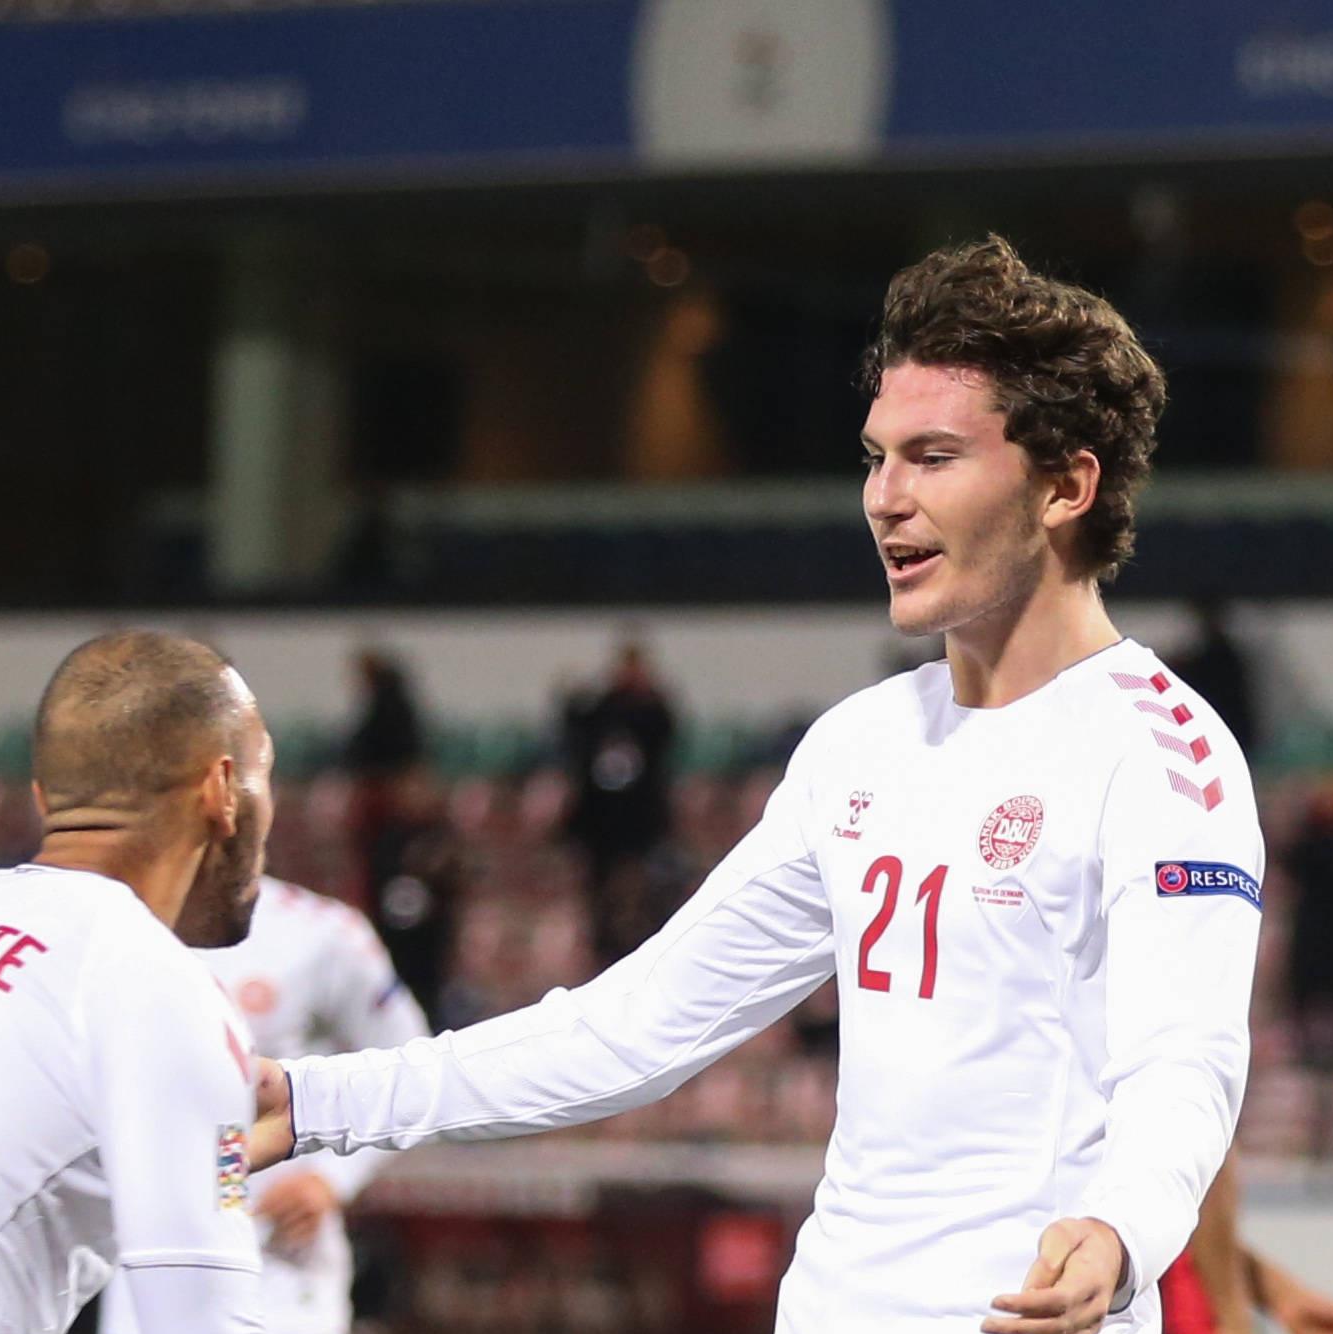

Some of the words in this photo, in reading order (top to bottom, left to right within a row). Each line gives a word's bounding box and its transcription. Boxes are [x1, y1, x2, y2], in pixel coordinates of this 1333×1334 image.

[992, 817, 1035, 844] DBU
[1191, 869, 1260, 902] RESPECT
[857, 855, 949, 1000] 21
